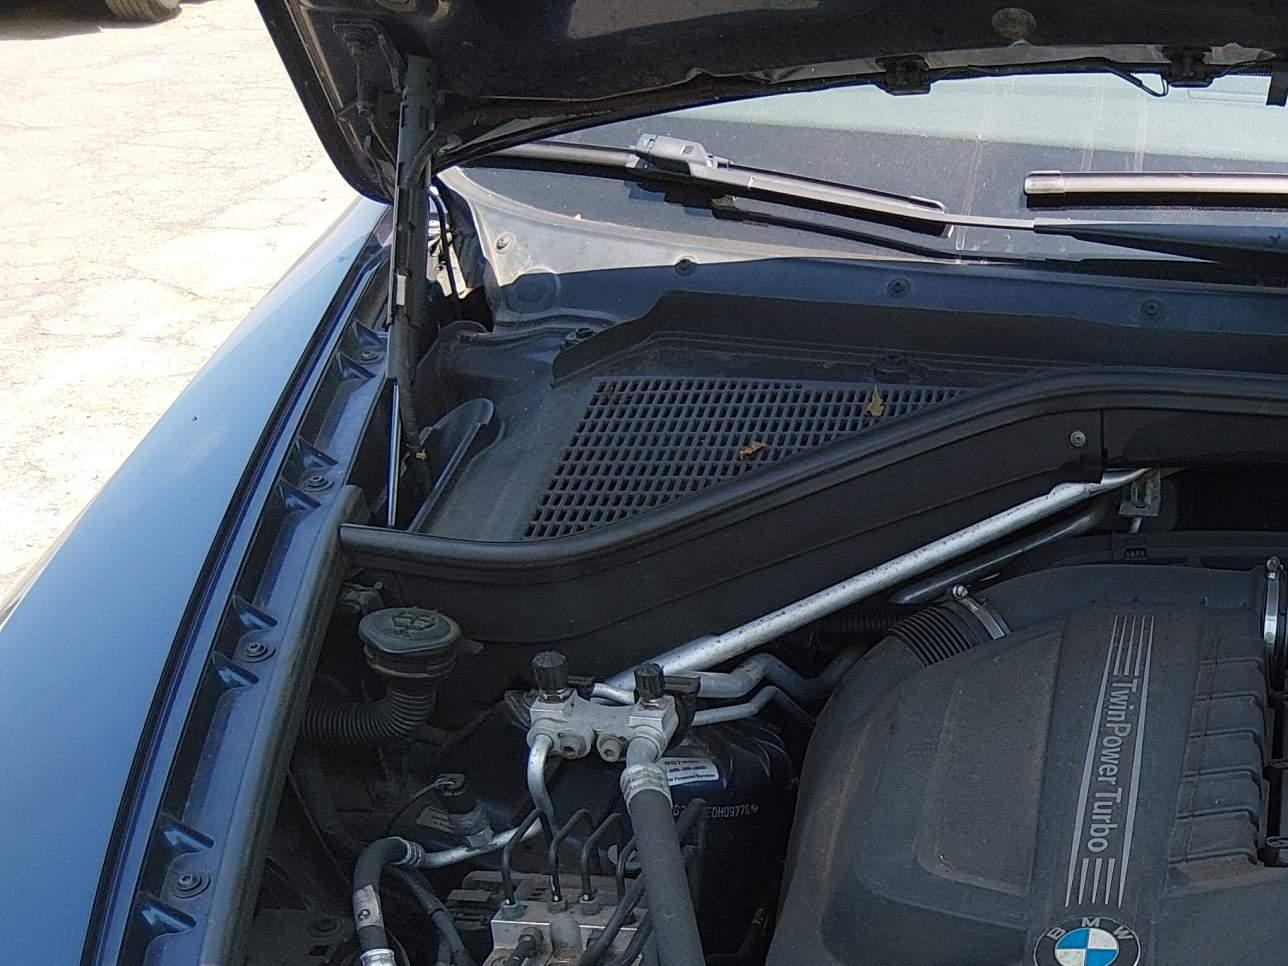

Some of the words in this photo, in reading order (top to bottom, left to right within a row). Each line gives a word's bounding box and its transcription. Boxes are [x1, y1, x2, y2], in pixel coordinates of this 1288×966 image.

[1097, 679, 1138, 785] TwinPower
[1087, 787, 1123, 853] Turbo
[1046, 916, 1134, 941] BMW
